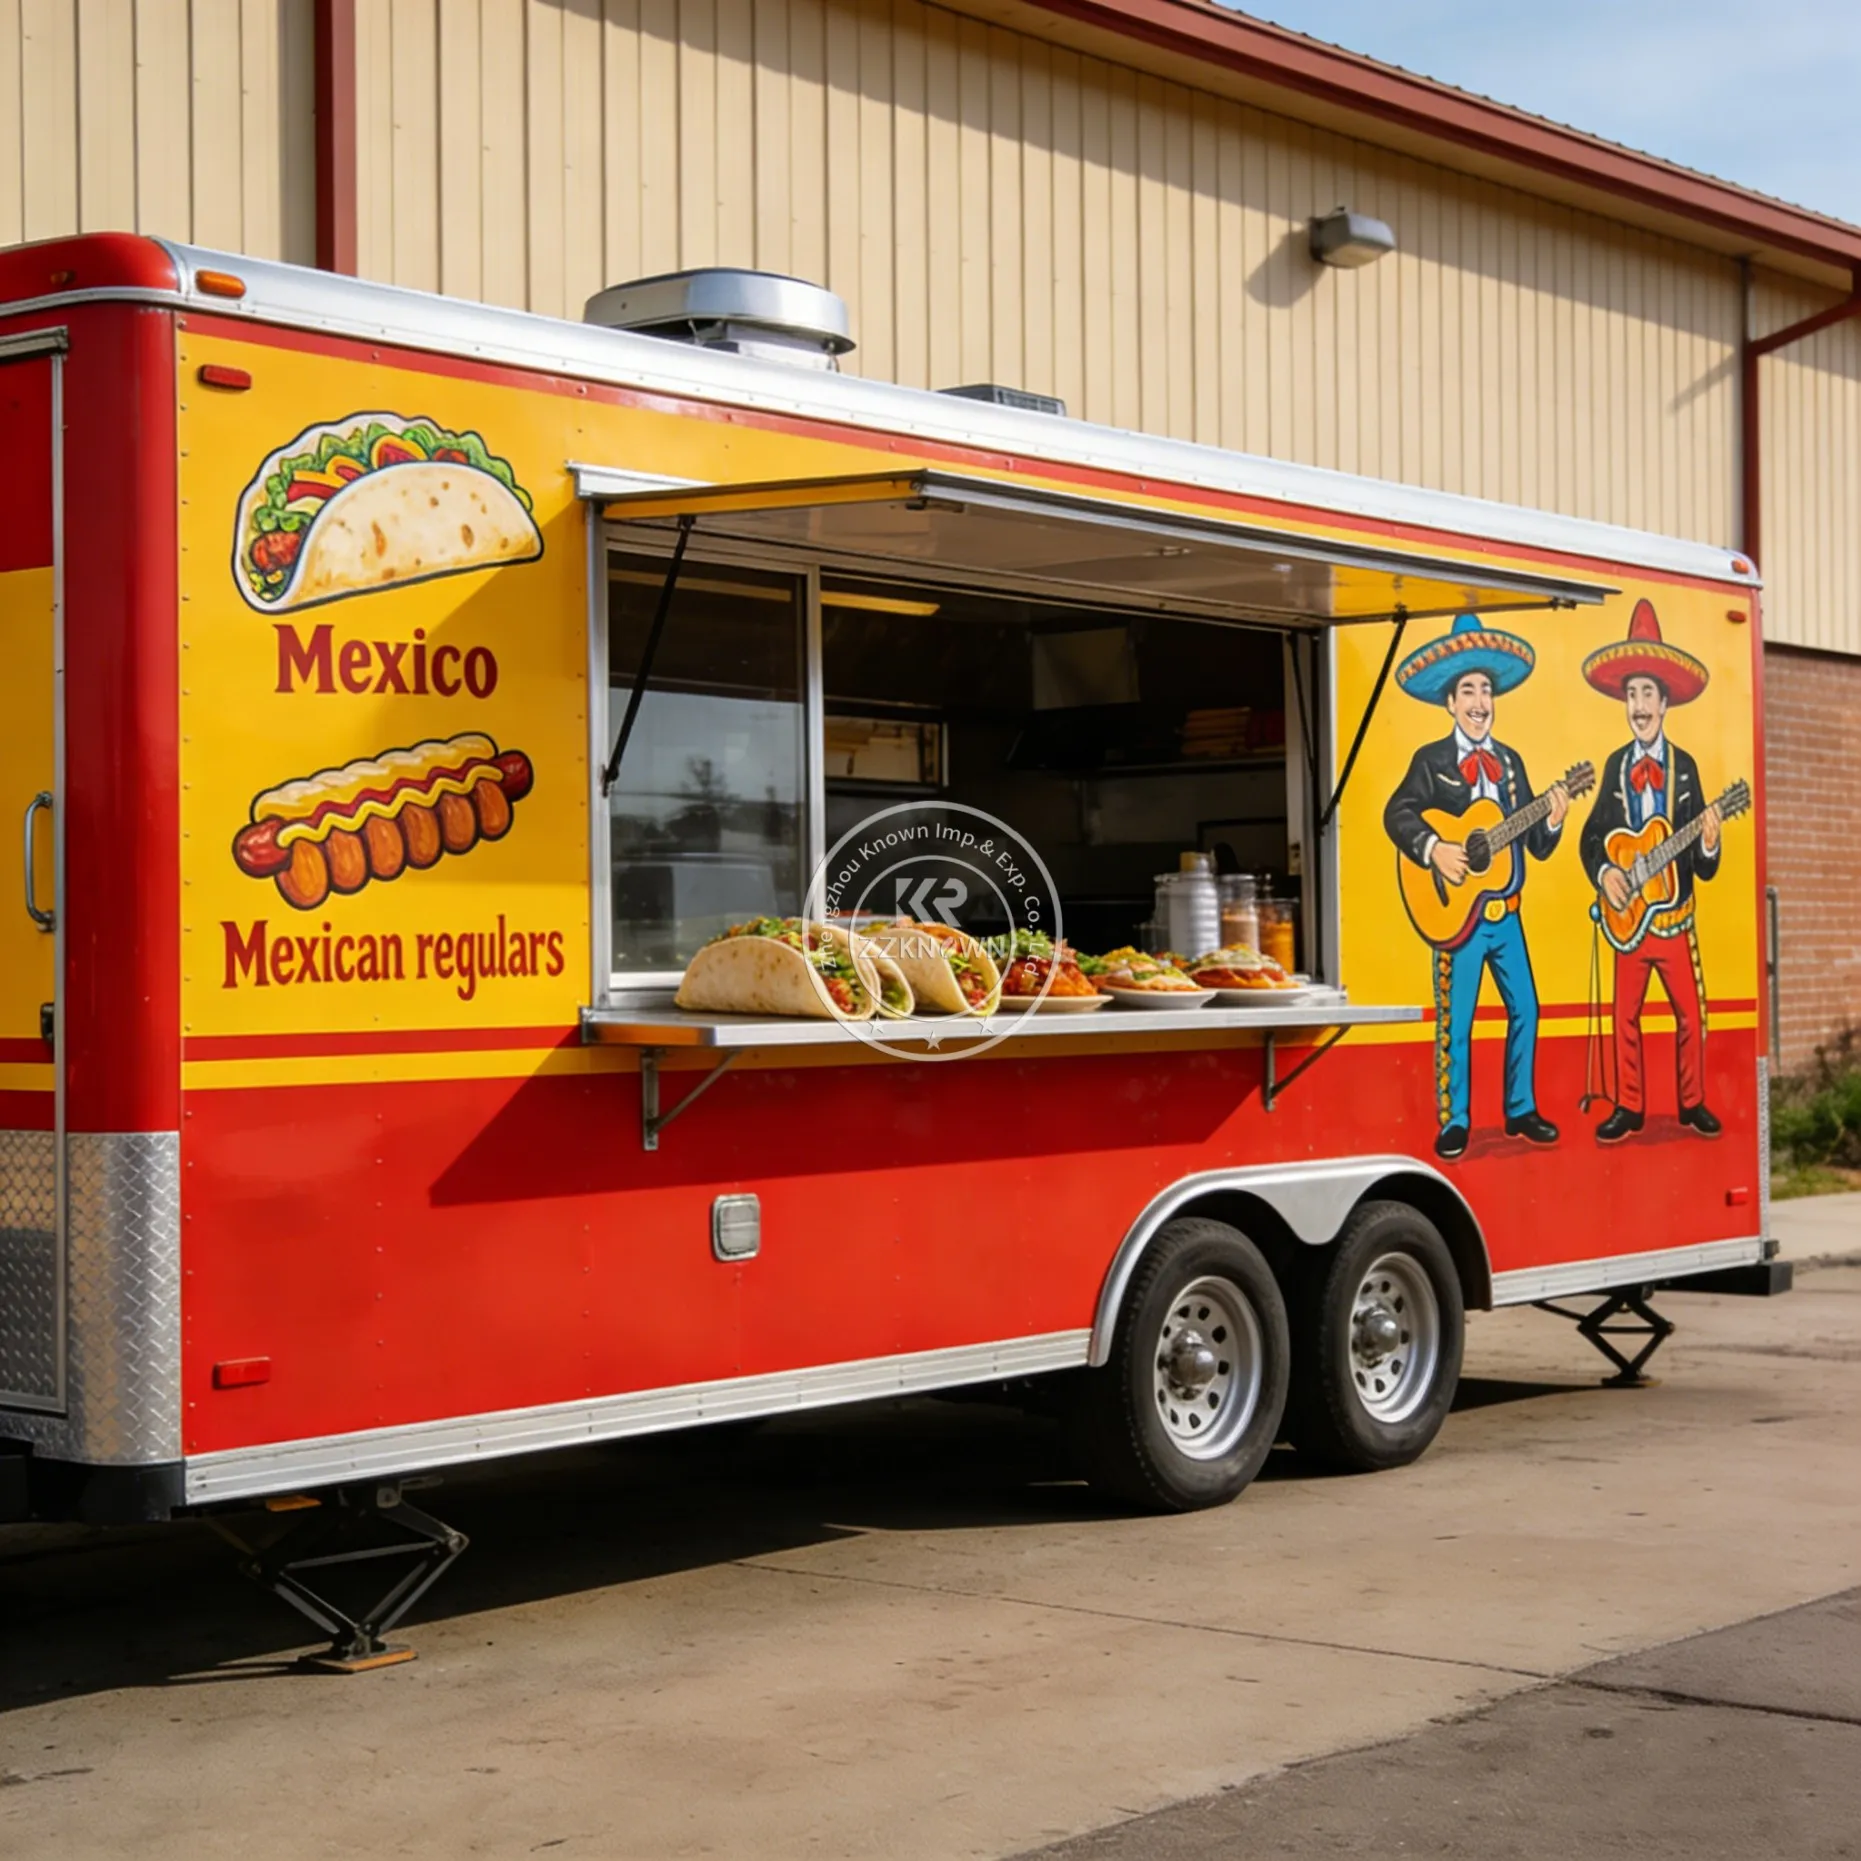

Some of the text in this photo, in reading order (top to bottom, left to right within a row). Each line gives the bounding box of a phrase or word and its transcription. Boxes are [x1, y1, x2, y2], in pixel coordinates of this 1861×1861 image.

[273, 624, 499, 699] Mexico
[220, 914, 566, 1001] Mexican regulars
